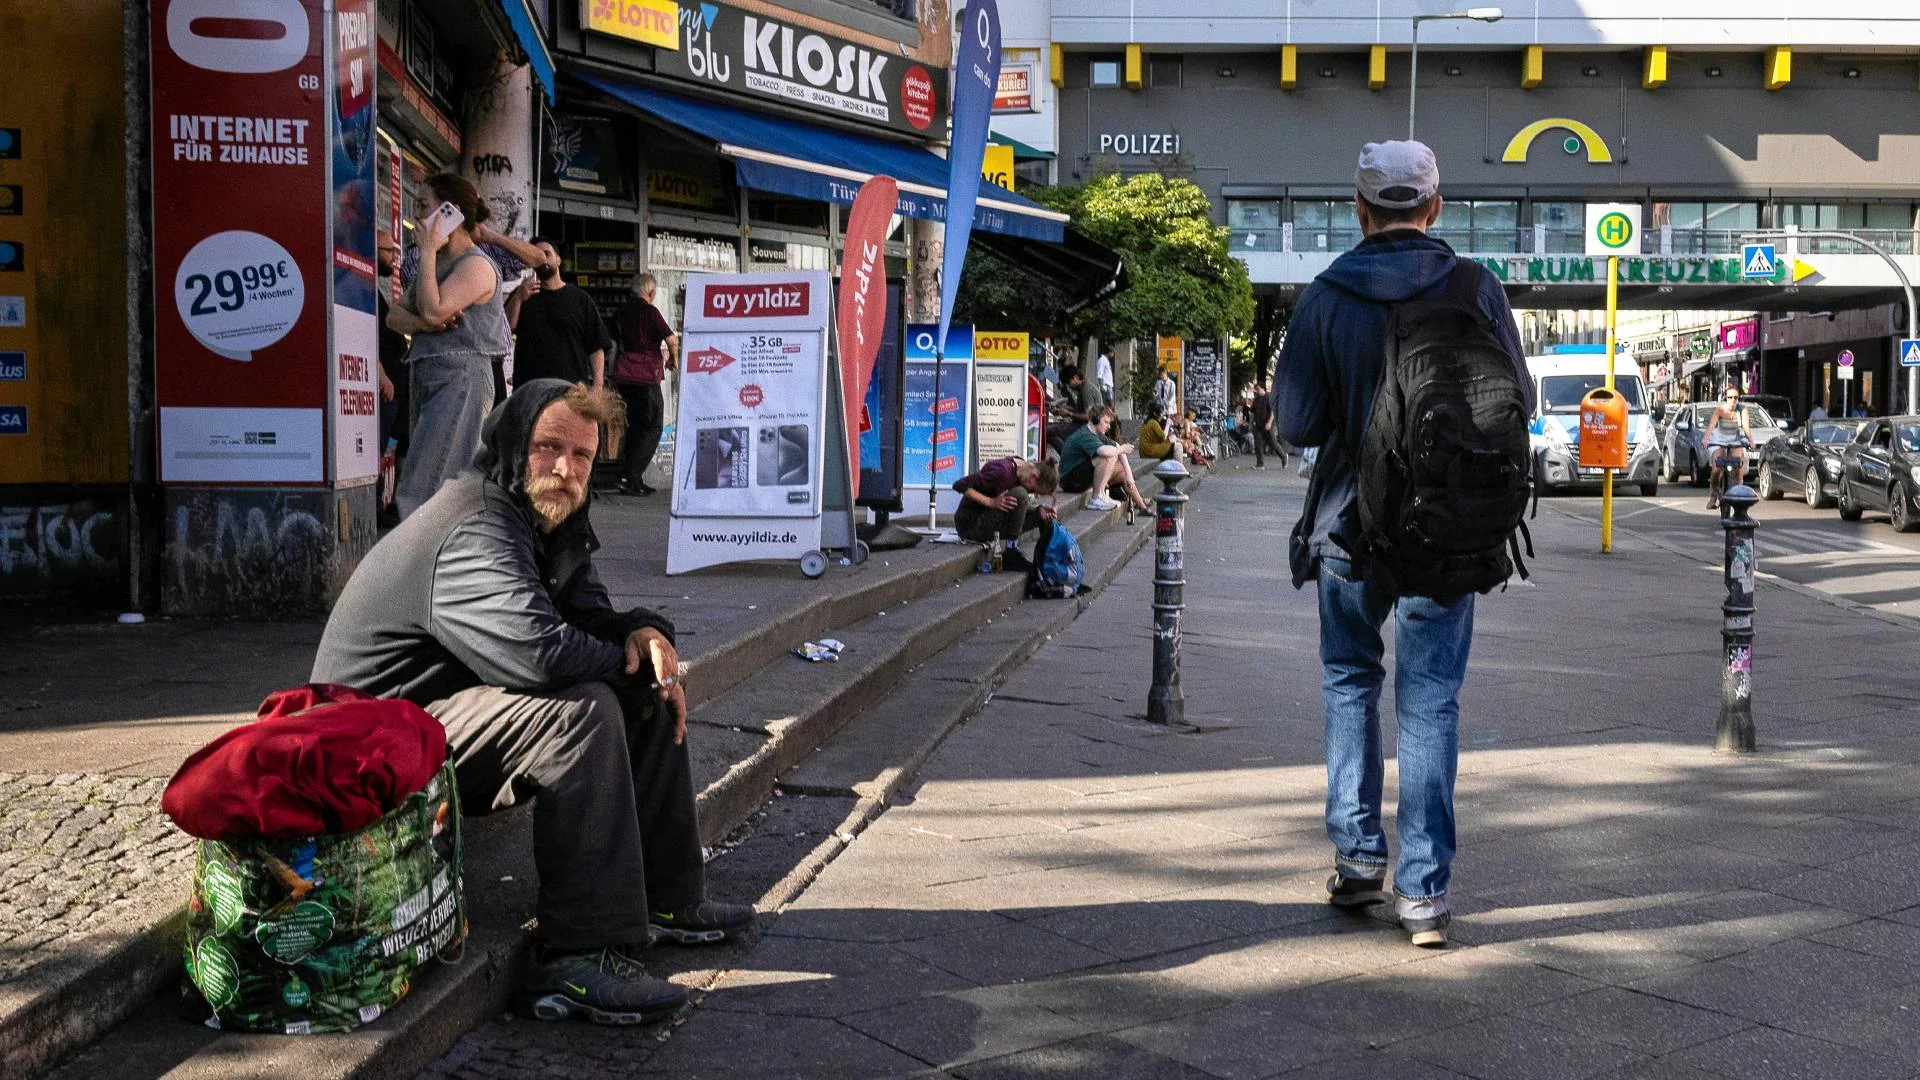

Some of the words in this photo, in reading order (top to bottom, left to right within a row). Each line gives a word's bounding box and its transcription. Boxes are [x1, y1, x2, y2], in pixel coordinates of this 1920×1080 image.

[619, 4, 673, 34] LOTTO
[338, 11, 367, 52] PREPAID
[687, 27, 730, 82] blu
[744, 16, 889, 102] KIOSK
[299, 75, 319, 90] GB
[350, 58, 363, 98] SIM
[974, 63, 983, 80] can
[984, 72, 990, 88] do
[749, 76, 779, 91] TOBACCO
[786, 85, 805, 98] PRESS
[812, 92, 835, 105] SNACKS
[842, 99, 864, 112] DRINKS
[871, 108, 886, 118] MORE
[170, 115, 309, 144] INTERNET
[173, 143, 212, 162] FÜR
[219, 147, 309, 165] ZUHAUSE
[1100, 133, 1180, 155] POLIZEI
[655, 172, 699, 198] LOTTO
[897, 198, 916, 213] tap
[1606, 221, 1624, 240] H
[752, 245, 786, 260] Souveni
[713, 293, 739, 314] ay
[743, 287, 801, 314] yıldız
[749, 336, 766, 348] 35
[768, 337, 783, 347] GB
[916, 332, 937, 354] O2
[975, 337, 1020, 350] LOTTO
[339, 353, 363, 381] INTERNET
[364, 357, 369, 383] &
[905, 369, 917, 378] per
[918, 367, 947, 376] Angeot
[905, 390, 924, 399] mited
[926, 390, 945, 399] Smrt
[693, 531, 798, 546] www.ayyildiz.de
